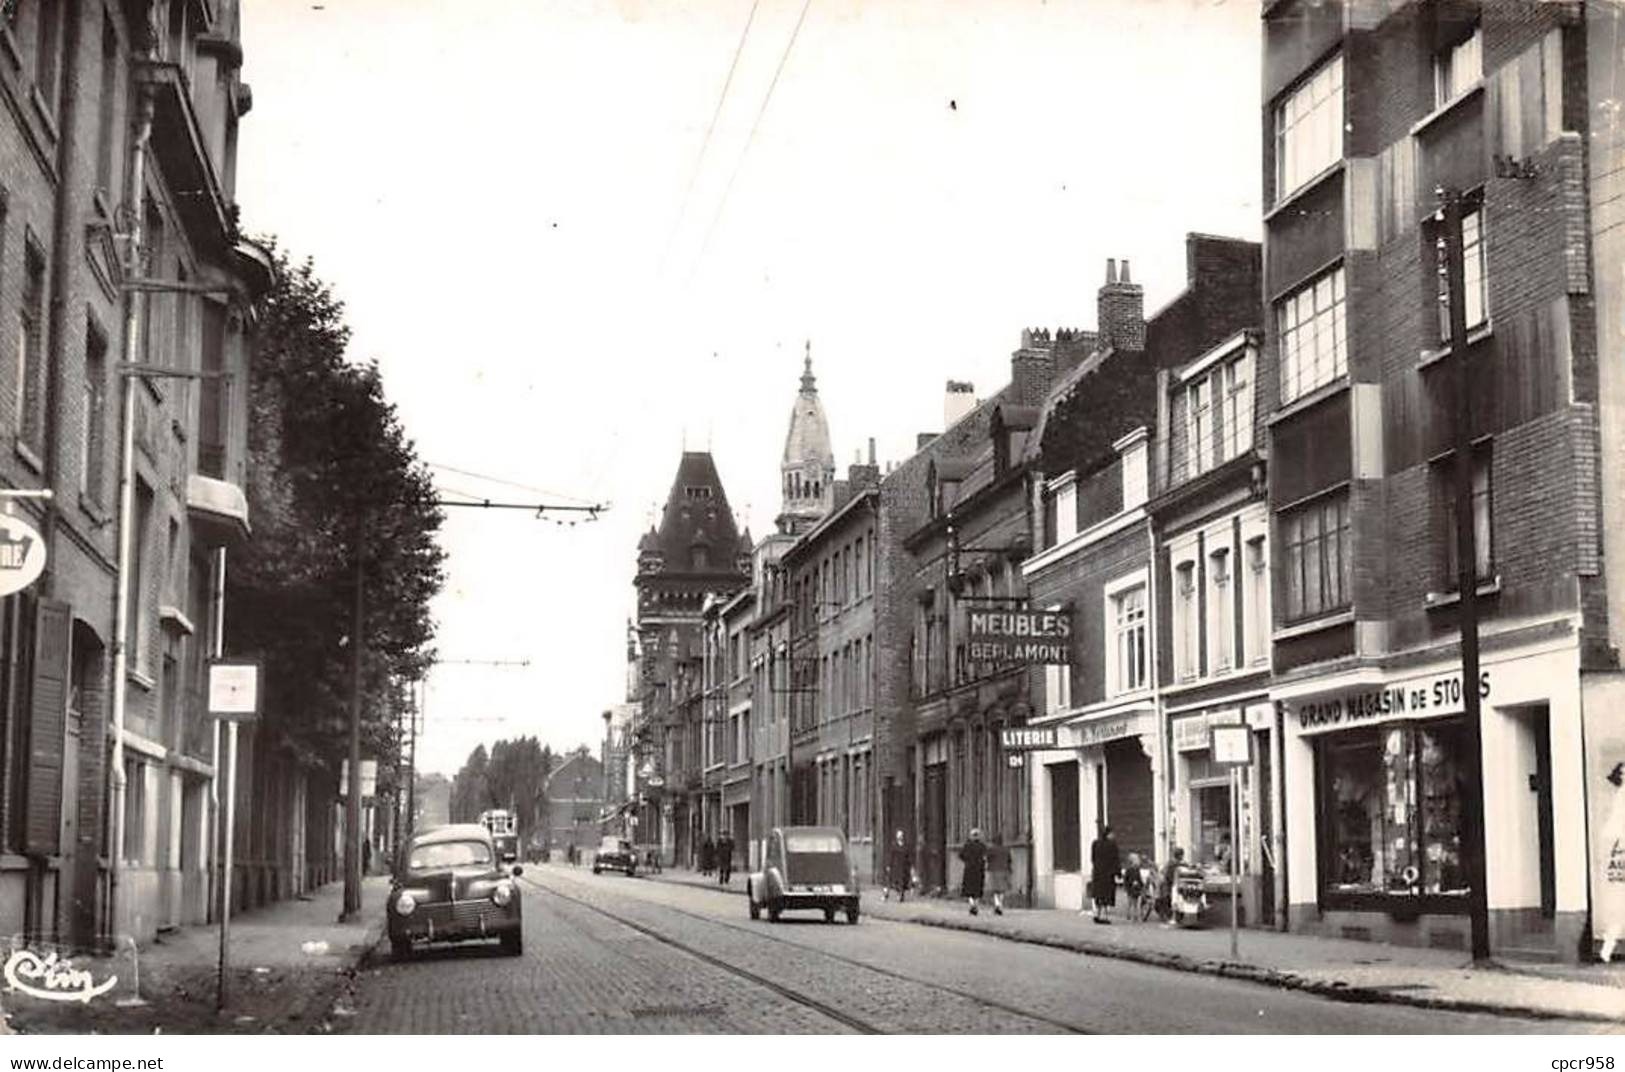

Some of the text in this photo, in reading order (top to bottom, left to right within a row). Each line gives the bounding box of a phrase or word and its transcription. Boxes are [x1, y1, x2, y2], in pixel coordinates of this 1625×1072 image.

[971, 613, 1070, 637] MEUBLES
[1300, 671, 1491, 729] GRAND MAGASIN DE STOS
[1002, 730, 1054, 746] LITERIE
